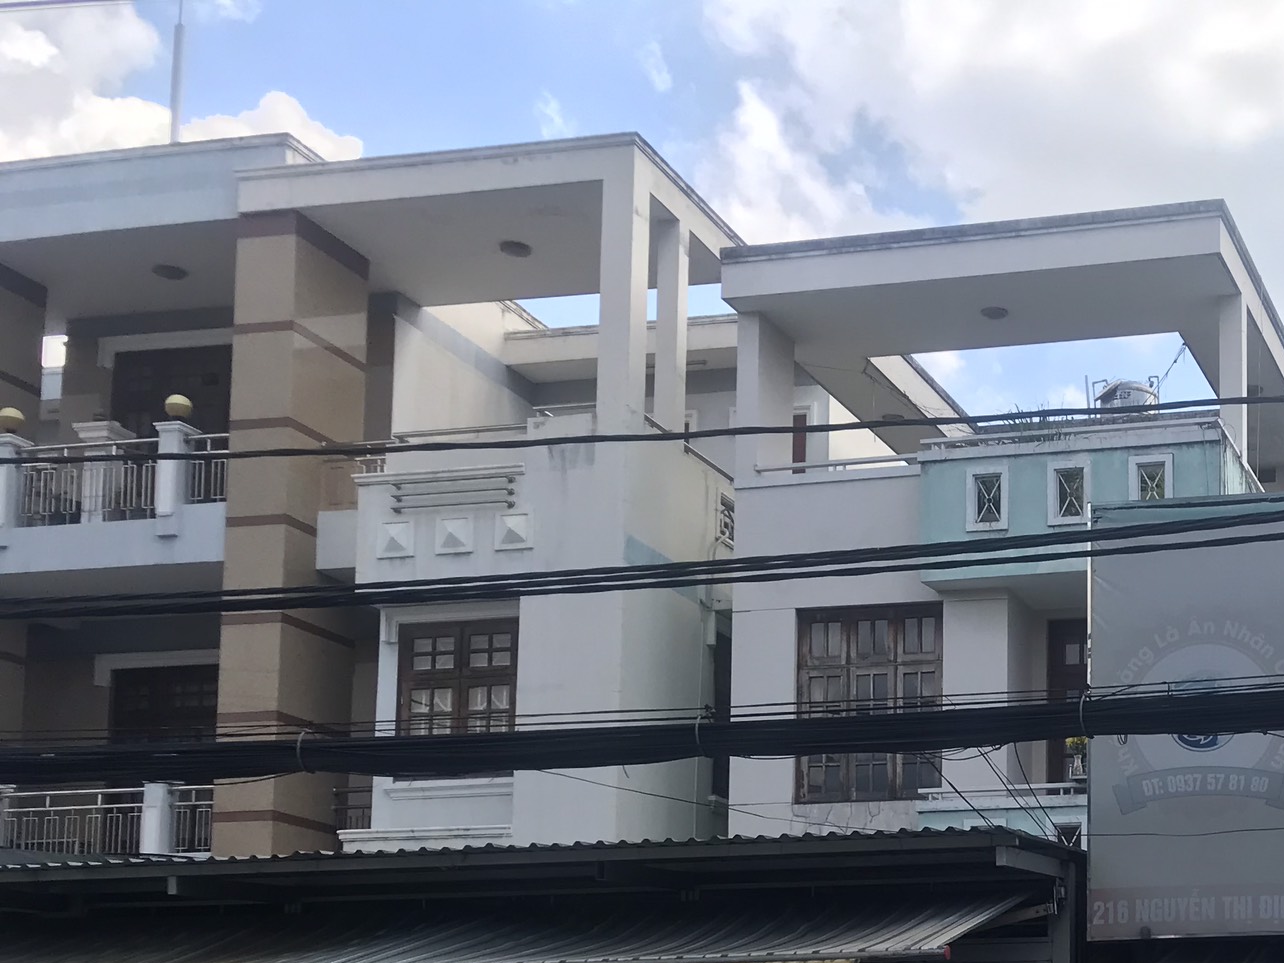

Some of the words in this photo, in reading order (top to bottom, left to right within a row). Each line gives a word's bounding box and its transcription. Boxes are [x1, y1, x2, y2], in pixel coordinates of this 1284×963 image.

[1222, 618, 1277, 659] Nhân
[1167, 773, 1202, 793] 0937
[1207, 773, 1225, 790] 57
[1229, 774, 1246, 791] 81
[1092, 900, 1129, 926] 216
[1134, 887, 1216, 924] NGUYỄN
[1222, 895, 1254, 928] THỊ
